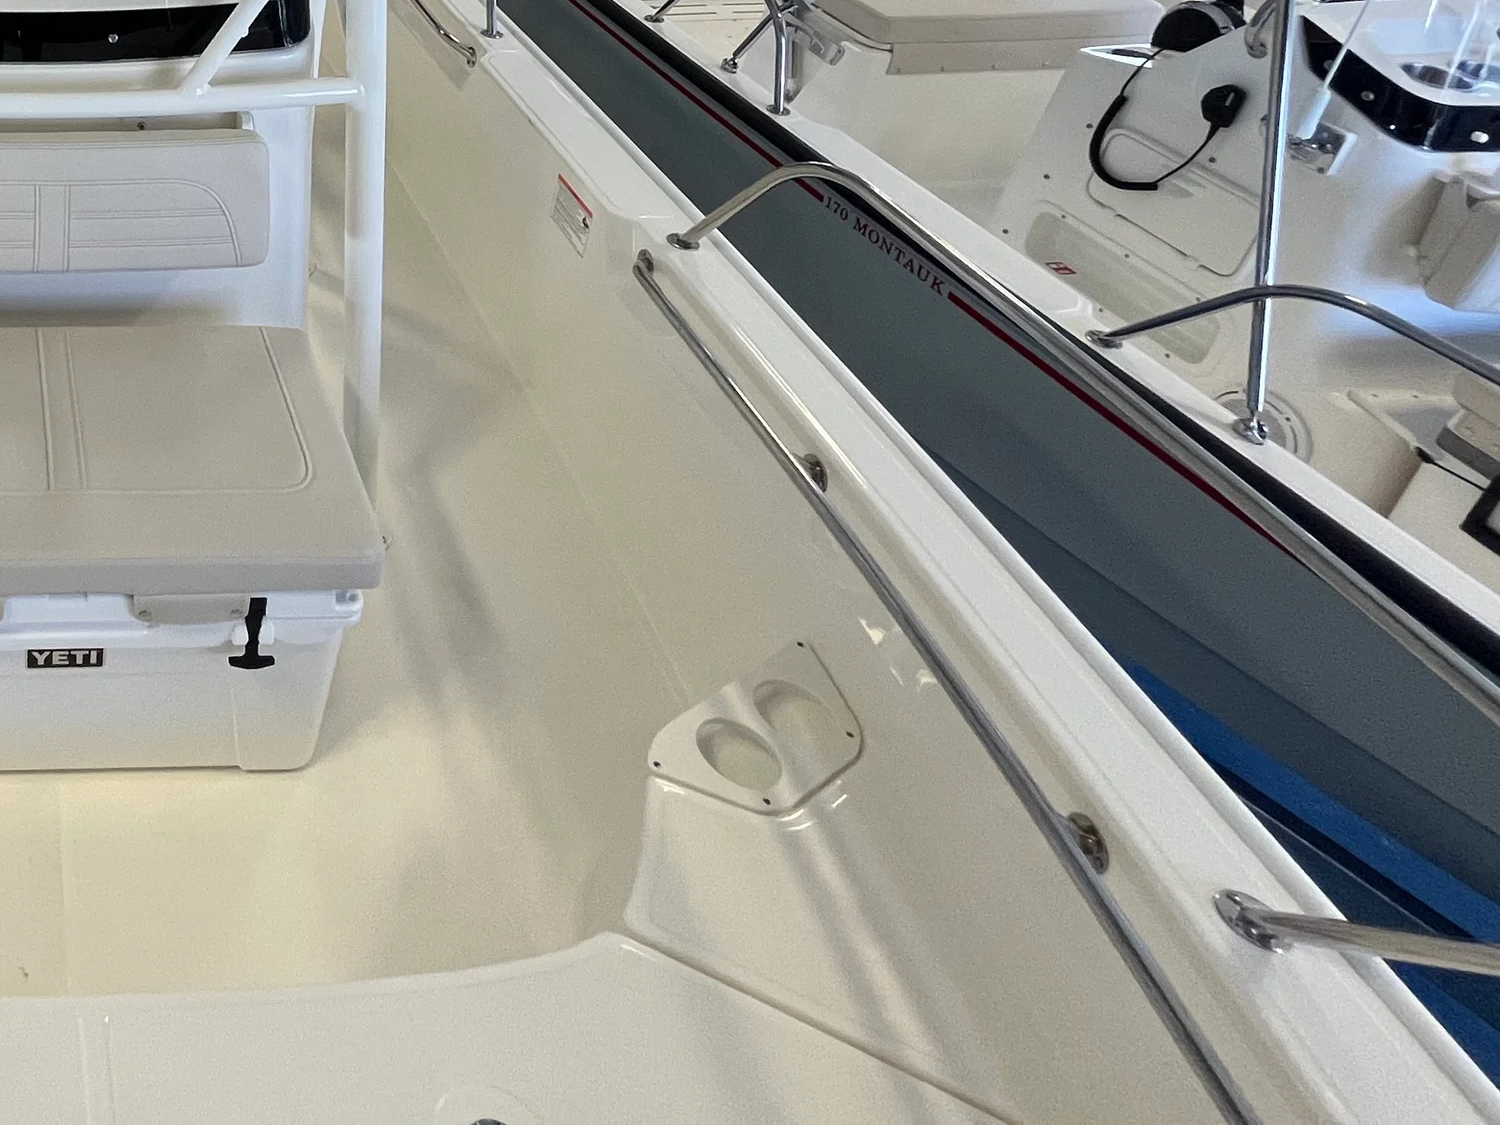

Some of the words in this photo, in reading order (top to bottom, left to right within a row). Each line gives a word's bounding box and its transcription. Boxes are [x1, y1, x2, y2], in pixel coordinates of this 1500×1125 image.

[825, 196, 849, 221] 170
[853, 216, 946, 296] MONTAUK
[31, 650, 97, 665] YETI
